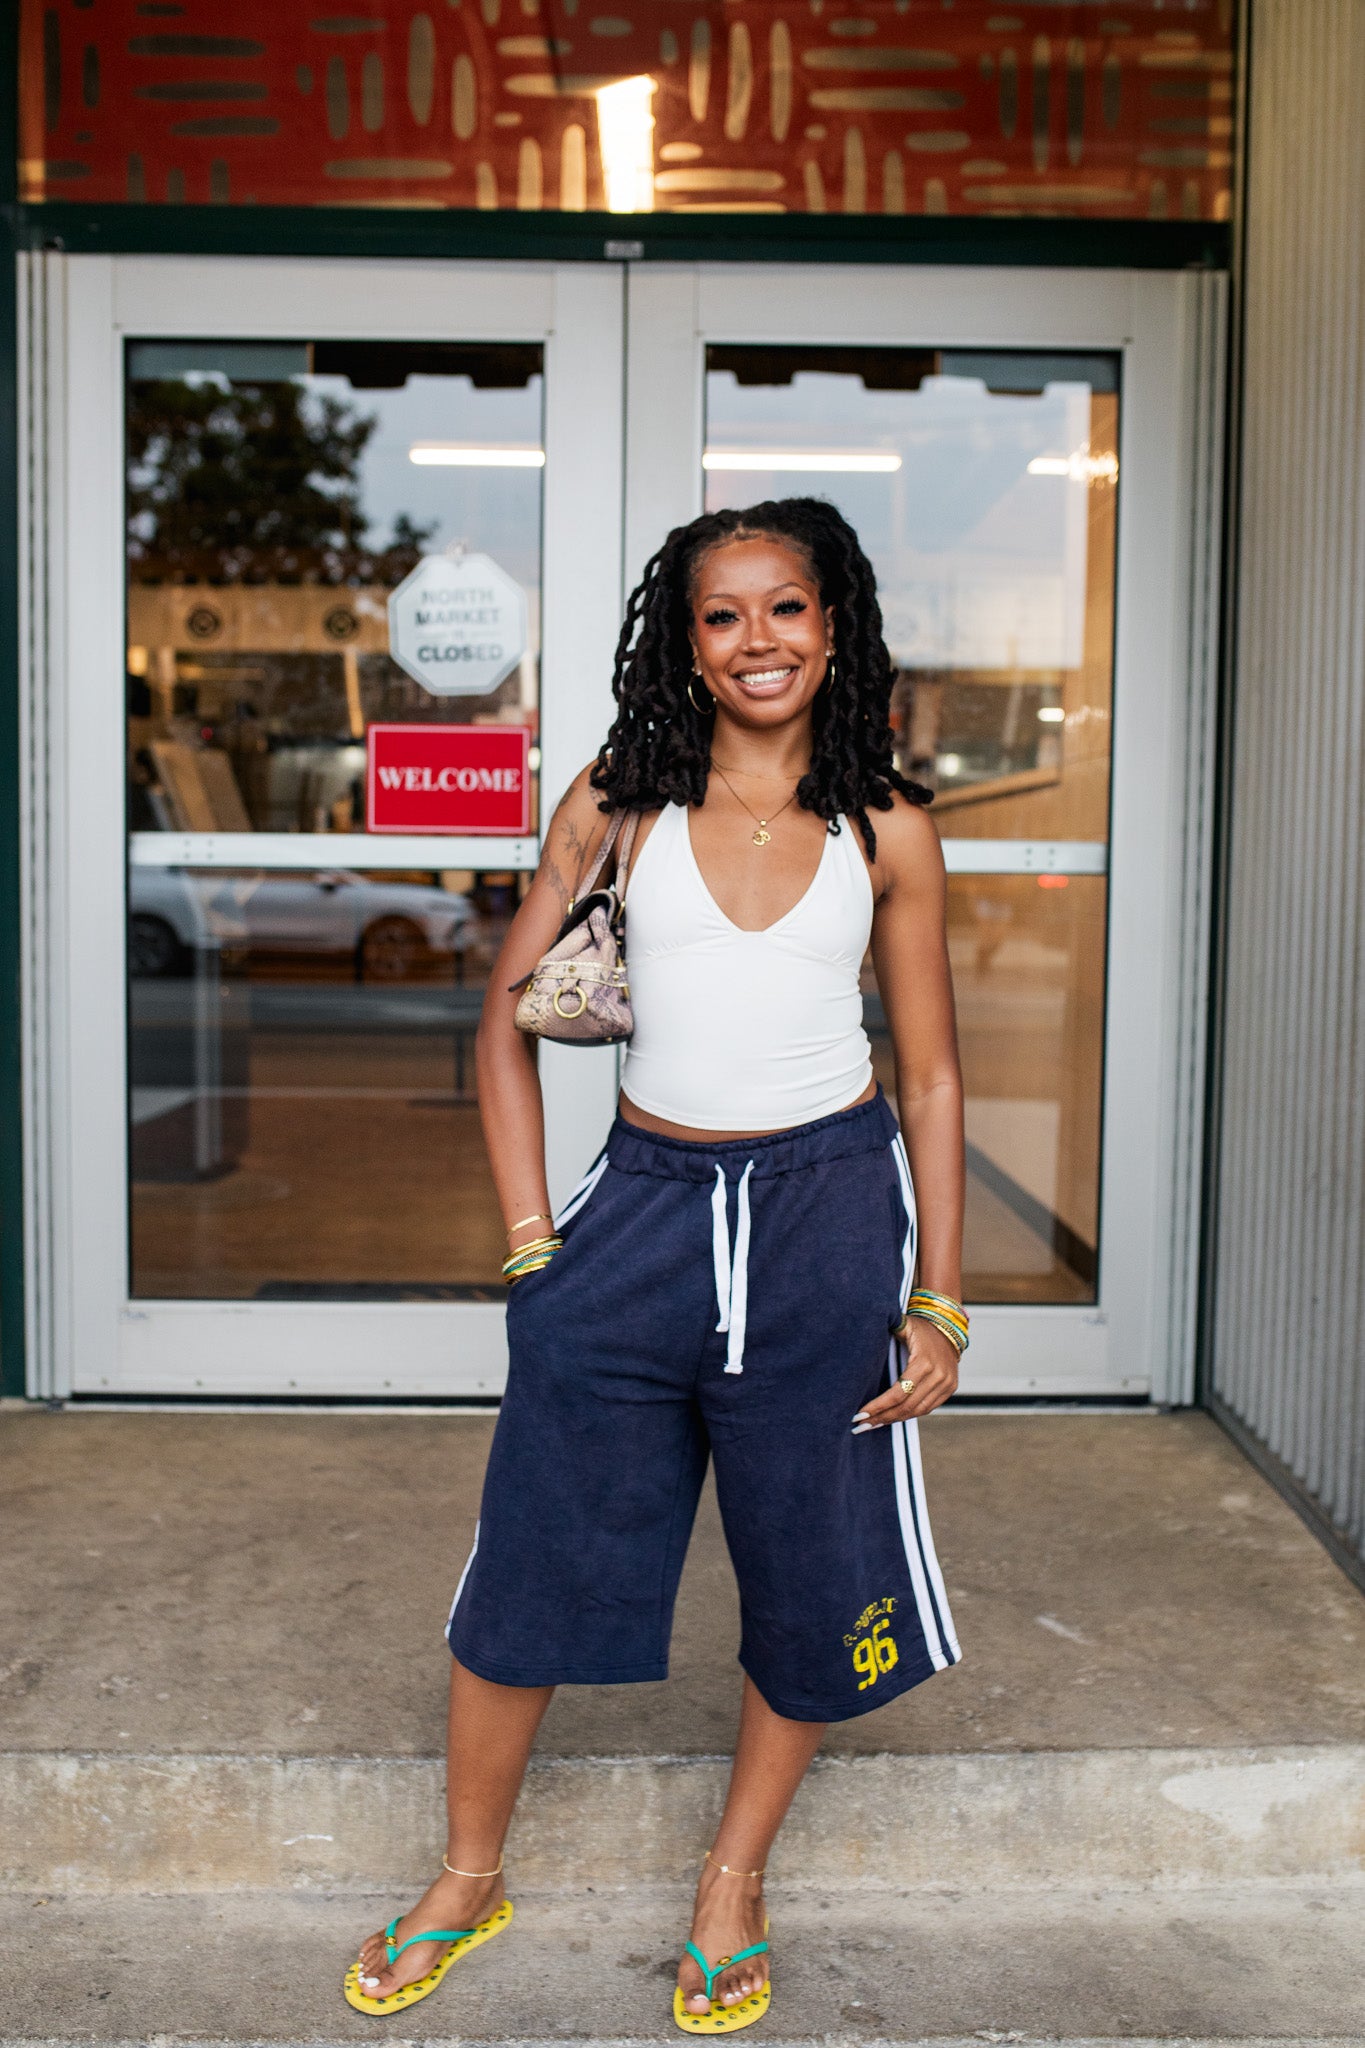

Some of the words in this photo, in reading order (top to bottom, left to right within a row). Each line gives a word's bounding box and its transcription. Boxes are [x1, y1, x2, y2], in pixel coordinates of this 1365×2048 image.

[421, 588, 494, 605] NORTH
[414, 608, 501, 626] MARKET
[417, 644, 503, 664] CLOSED
[378, 766, 521, 792] WELCOME
[853, 1619, 899, 1690] 96
